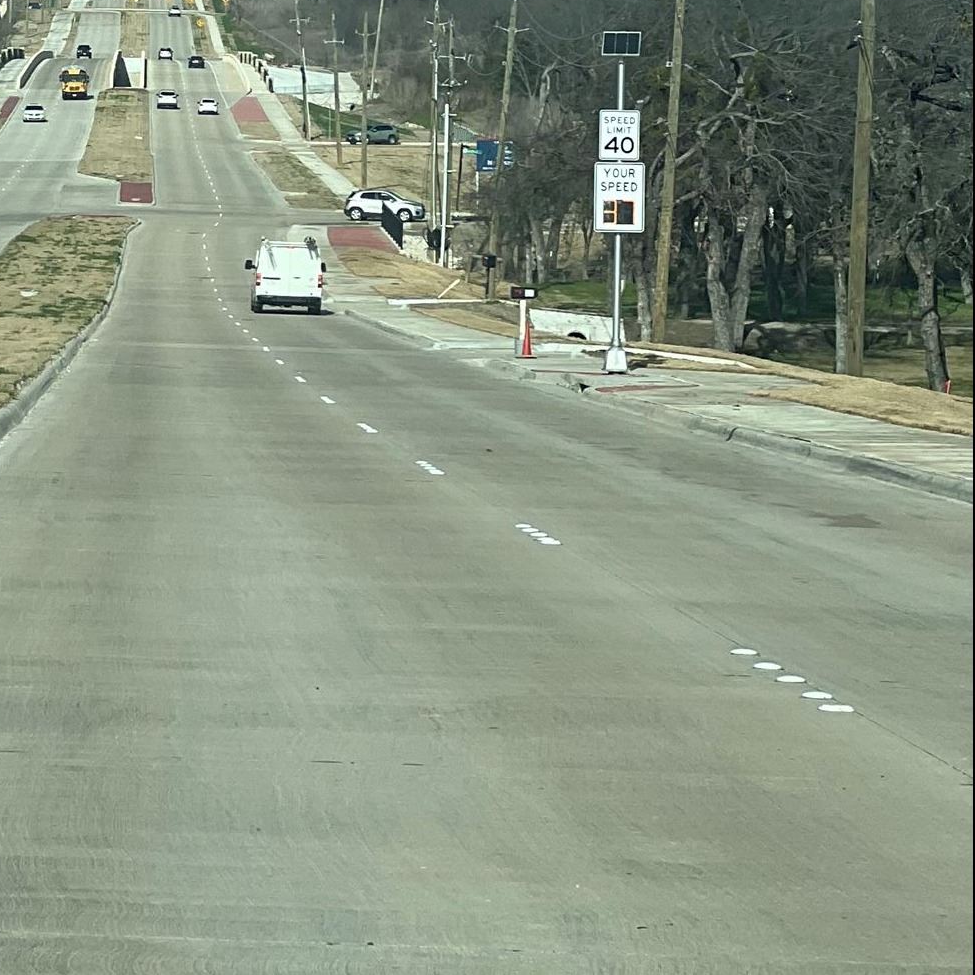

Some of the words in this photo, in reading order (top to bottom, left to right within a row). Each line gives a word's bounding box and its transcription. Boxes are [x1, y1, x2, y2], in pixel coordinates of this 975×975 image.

[604, 116, 636, 124] SPEED
[607, 126, 631, 134] LIMIT
[604, 136, 634, 154] 40
[604, 168, 636, 178] YOUR
[600, 181, 638, 192] SPEED
